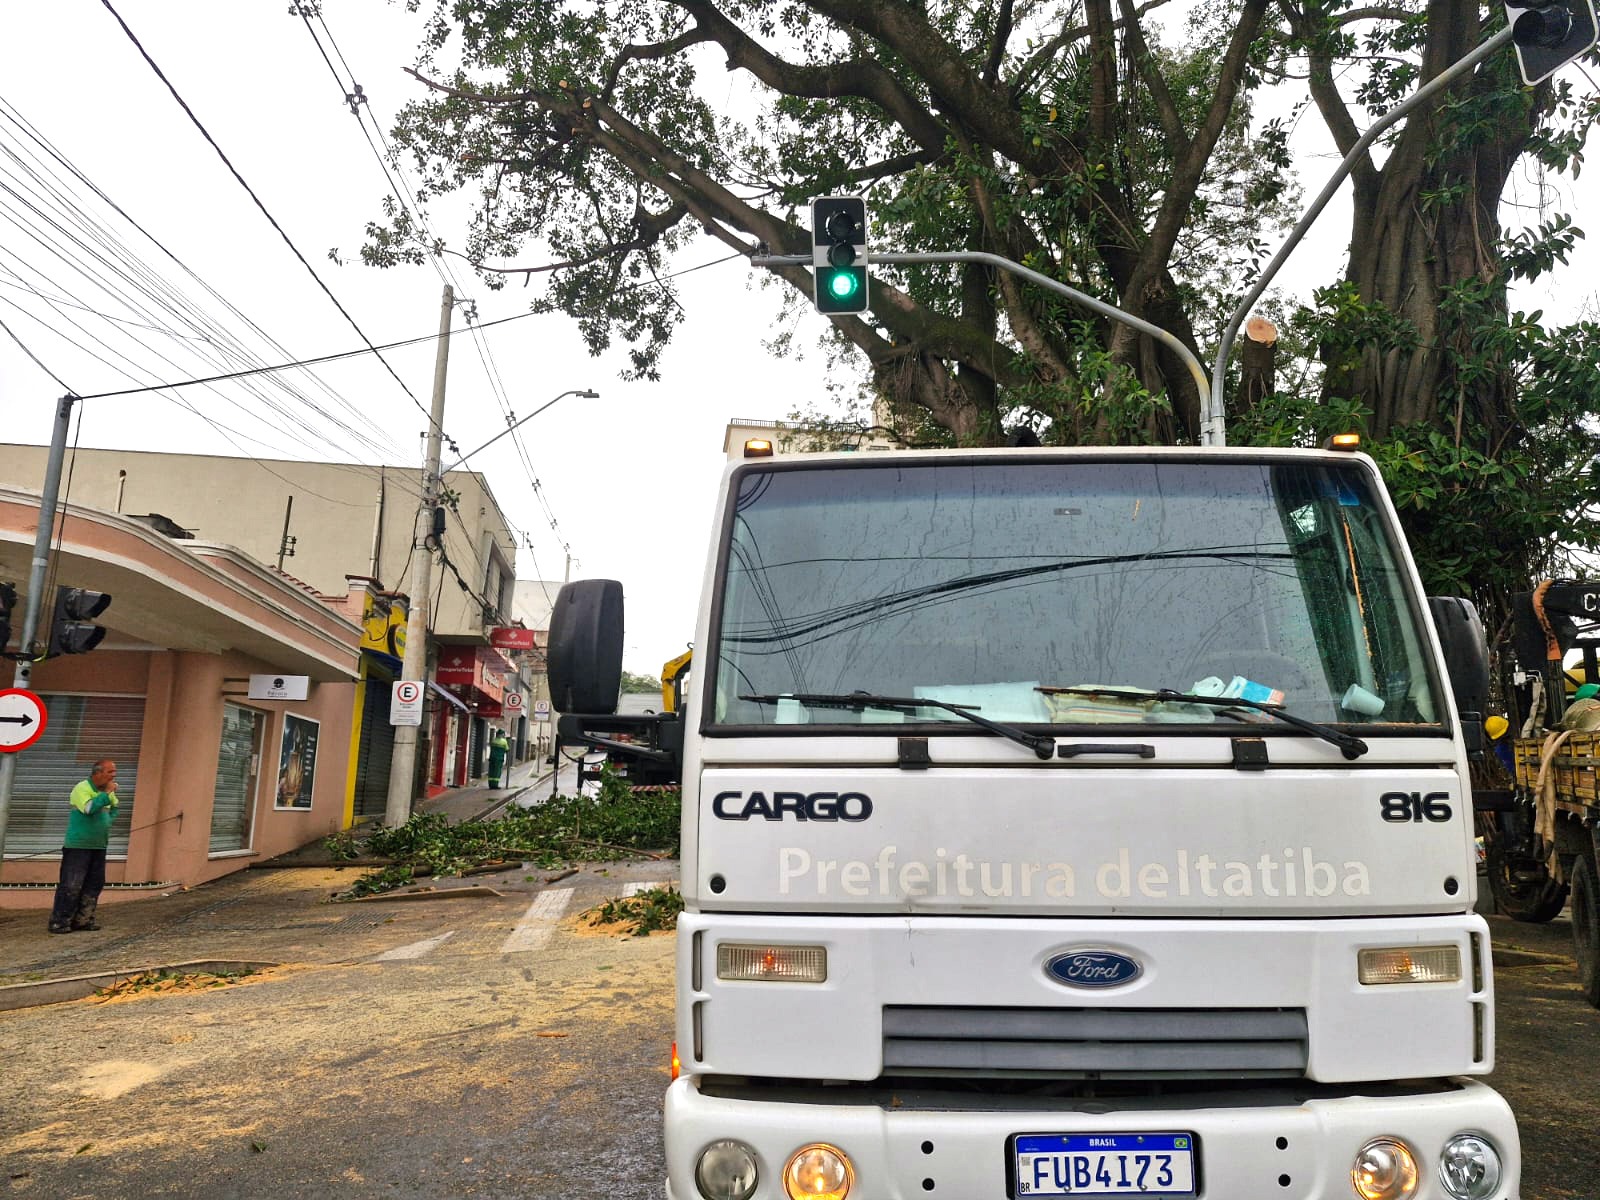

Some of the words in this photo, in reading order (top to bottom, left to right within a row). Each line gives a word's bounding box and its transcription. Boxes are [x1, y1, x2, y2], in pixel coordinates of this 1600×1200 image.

[404, 686, 412, 698] E
[712, 791, 873, 822] CARGO
[1380, 792, 1452, 823] 816
[779, 846, 1075, 897] Prefeitura
[1067, 955, 1121, 978] Ford
[1089, 1138, 1117, 1147] BRASIL
[1033, 1155, 1174, 1189] FUB4I73
[1020, 1182, 1031, 1193] BR
